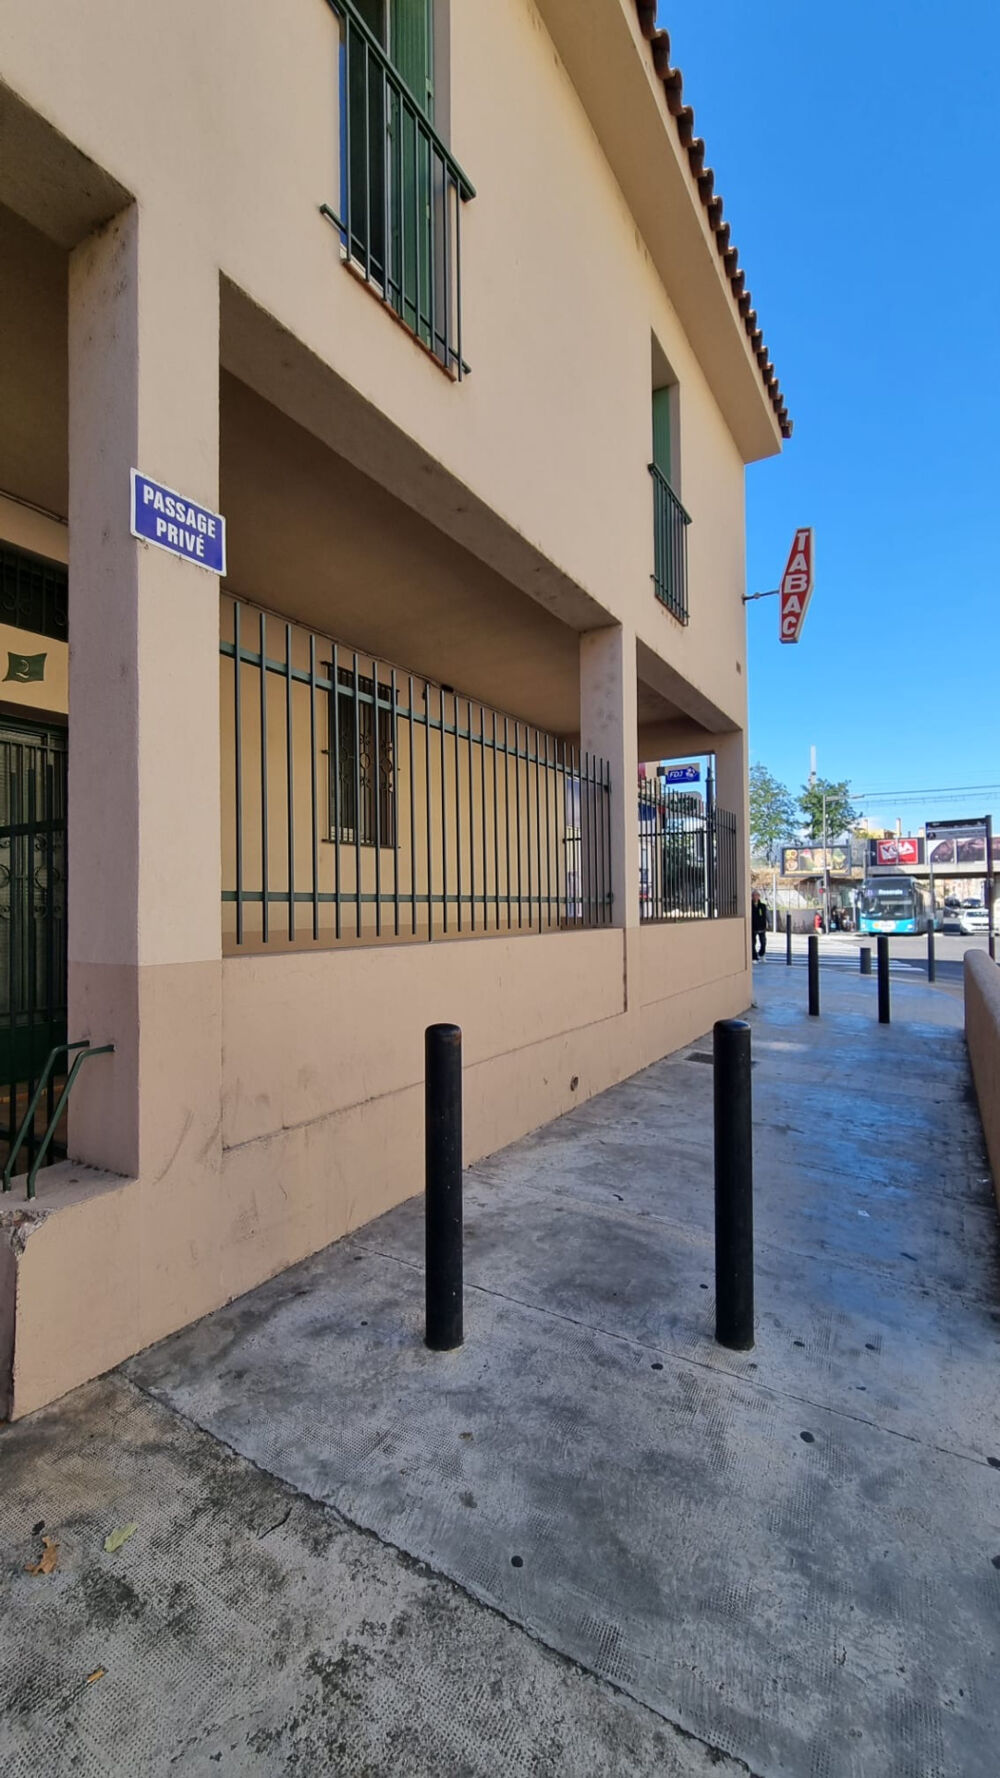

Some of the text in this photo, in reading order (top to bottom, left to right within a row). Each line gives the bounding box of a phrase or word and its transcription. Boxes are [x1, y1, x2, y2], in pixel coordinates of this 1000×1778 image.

[143, 484, 216, 539] PASSAGE
[156, 517, 205, 558] PRIVÉ
[782, 531, 809, 635] TABAC
[15, 658, 30, 679] 2
[669, 770, 684, 778] FDJ
